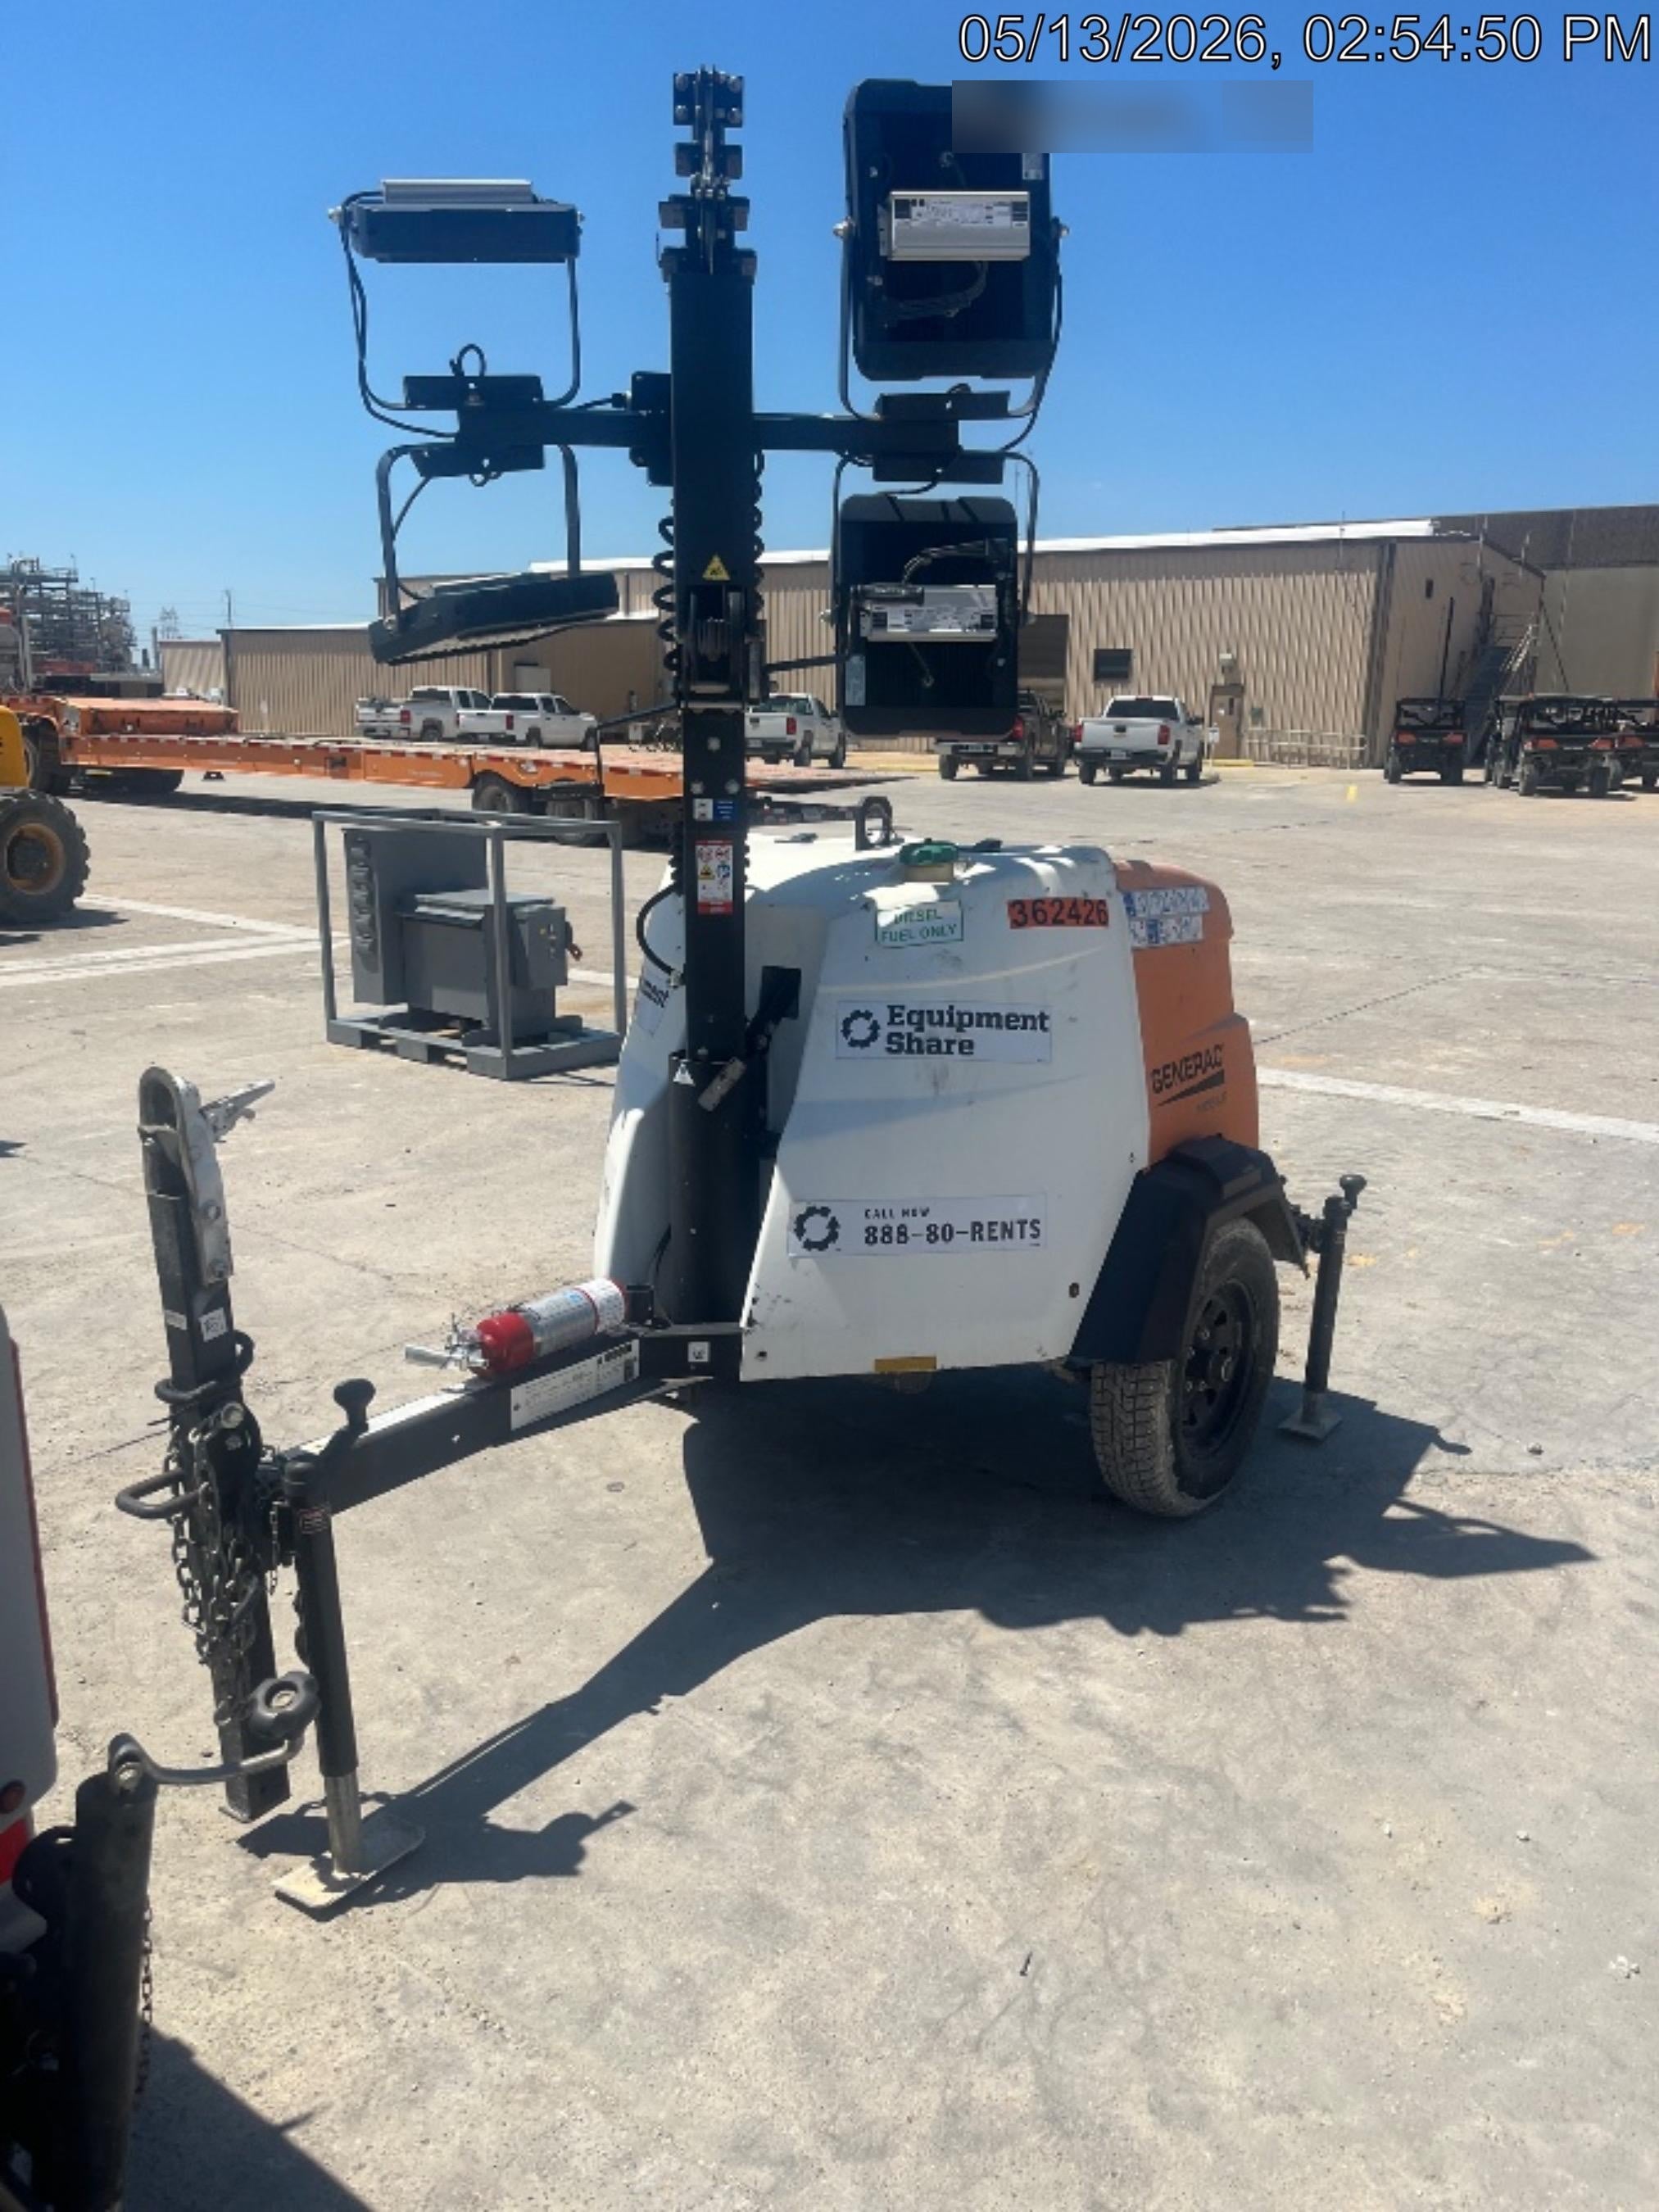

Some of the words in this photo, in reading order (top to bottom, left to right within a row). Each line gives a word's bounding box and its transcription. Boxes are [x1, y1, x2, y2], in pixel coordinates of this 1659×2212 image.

[1010, 898, 1108, 927] 362426
[882, 928, 915, 942] FUEL
[919, 923, 957, 939] ONLY
[886, 1004, 1049, 1032] Equipment
[885, 1031, 974, 1055] Share
[1151, 1043, 1223, 1094] GENERAC
[864, 1208, 895, 1220] CALL
[864, 1218, 1040, 1245] 888-80-RENTS
